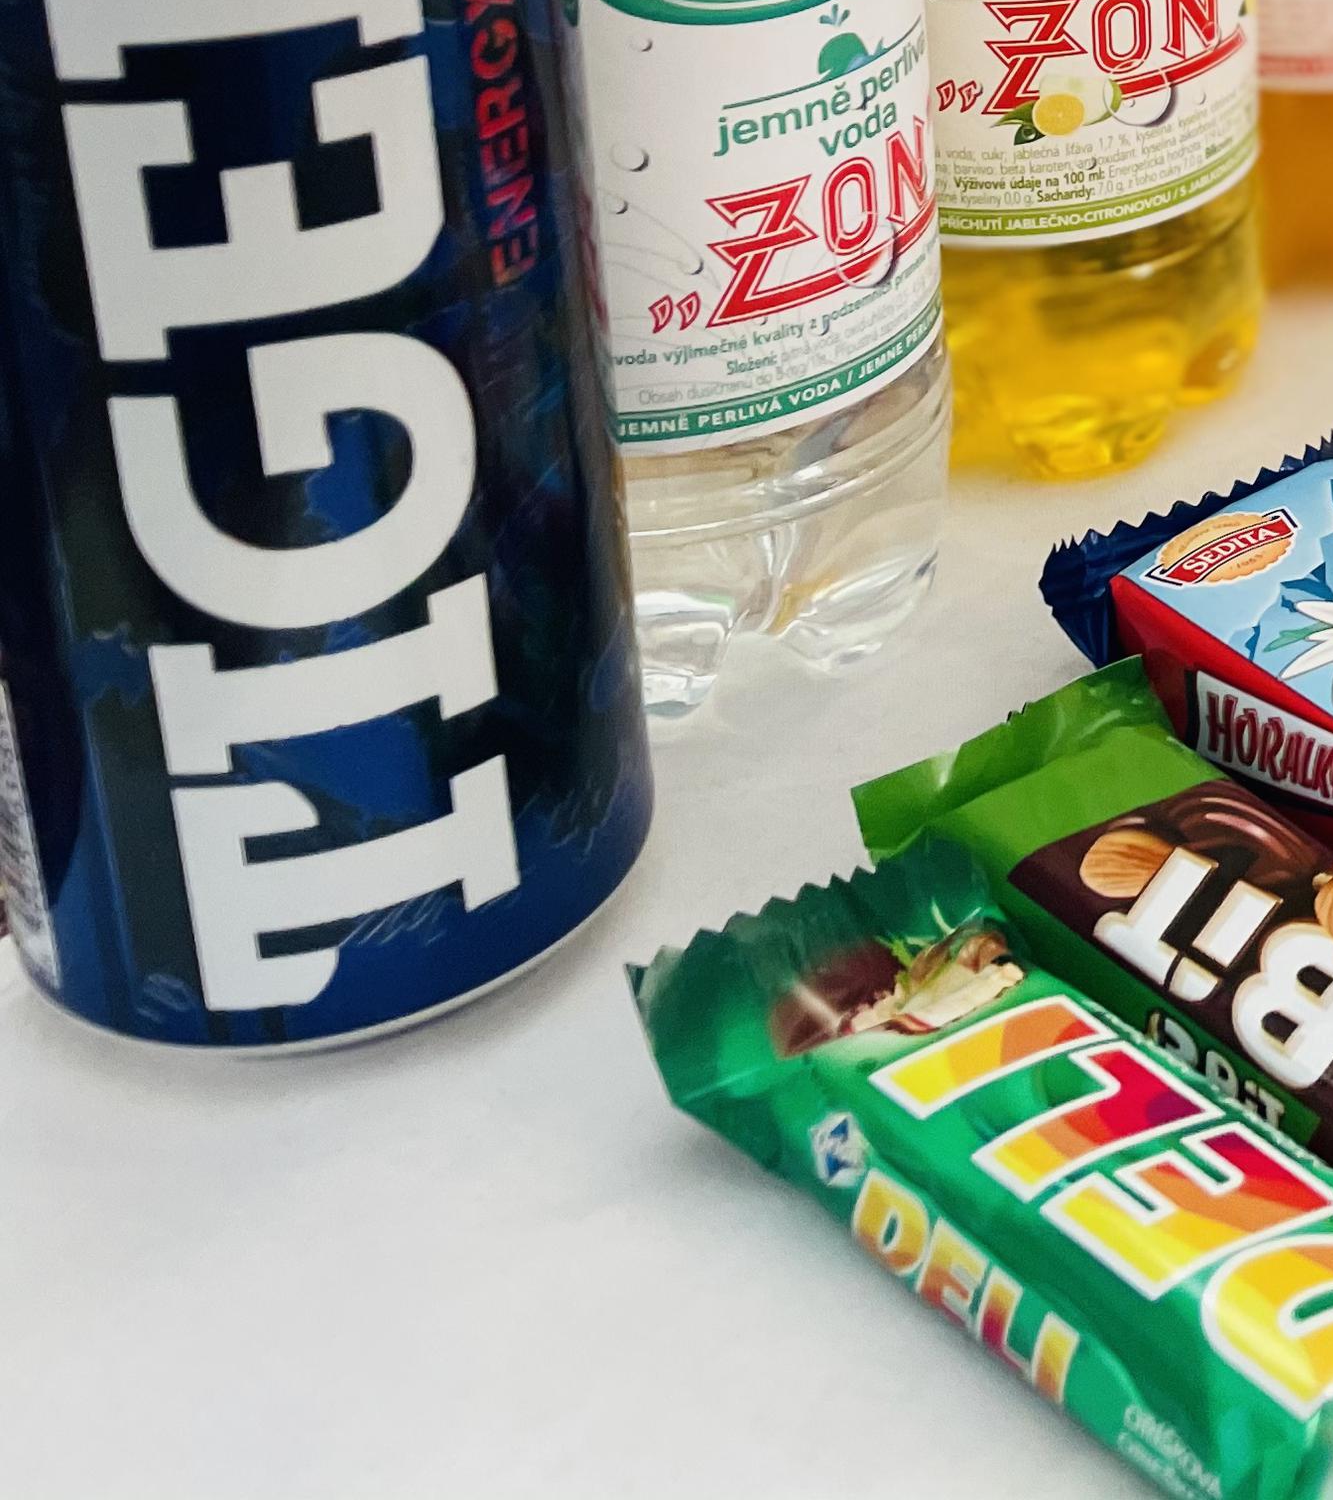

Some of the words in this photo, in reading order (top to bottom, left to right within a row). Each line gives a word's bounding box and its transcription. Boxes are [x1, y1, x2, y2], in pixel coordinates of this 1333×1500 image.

[713, 81, 851, 157] jemně
[819, 100, 898, 157] voda
[617, 413, 689, 438] JEMNĚ
[698, 396, 781, 429] PERLIVÁ
[789, 378, 842, 406] VODA
[1182, 527, 1279, 574] SEDITA
[853, 1167, 1081, 1407] DELI
